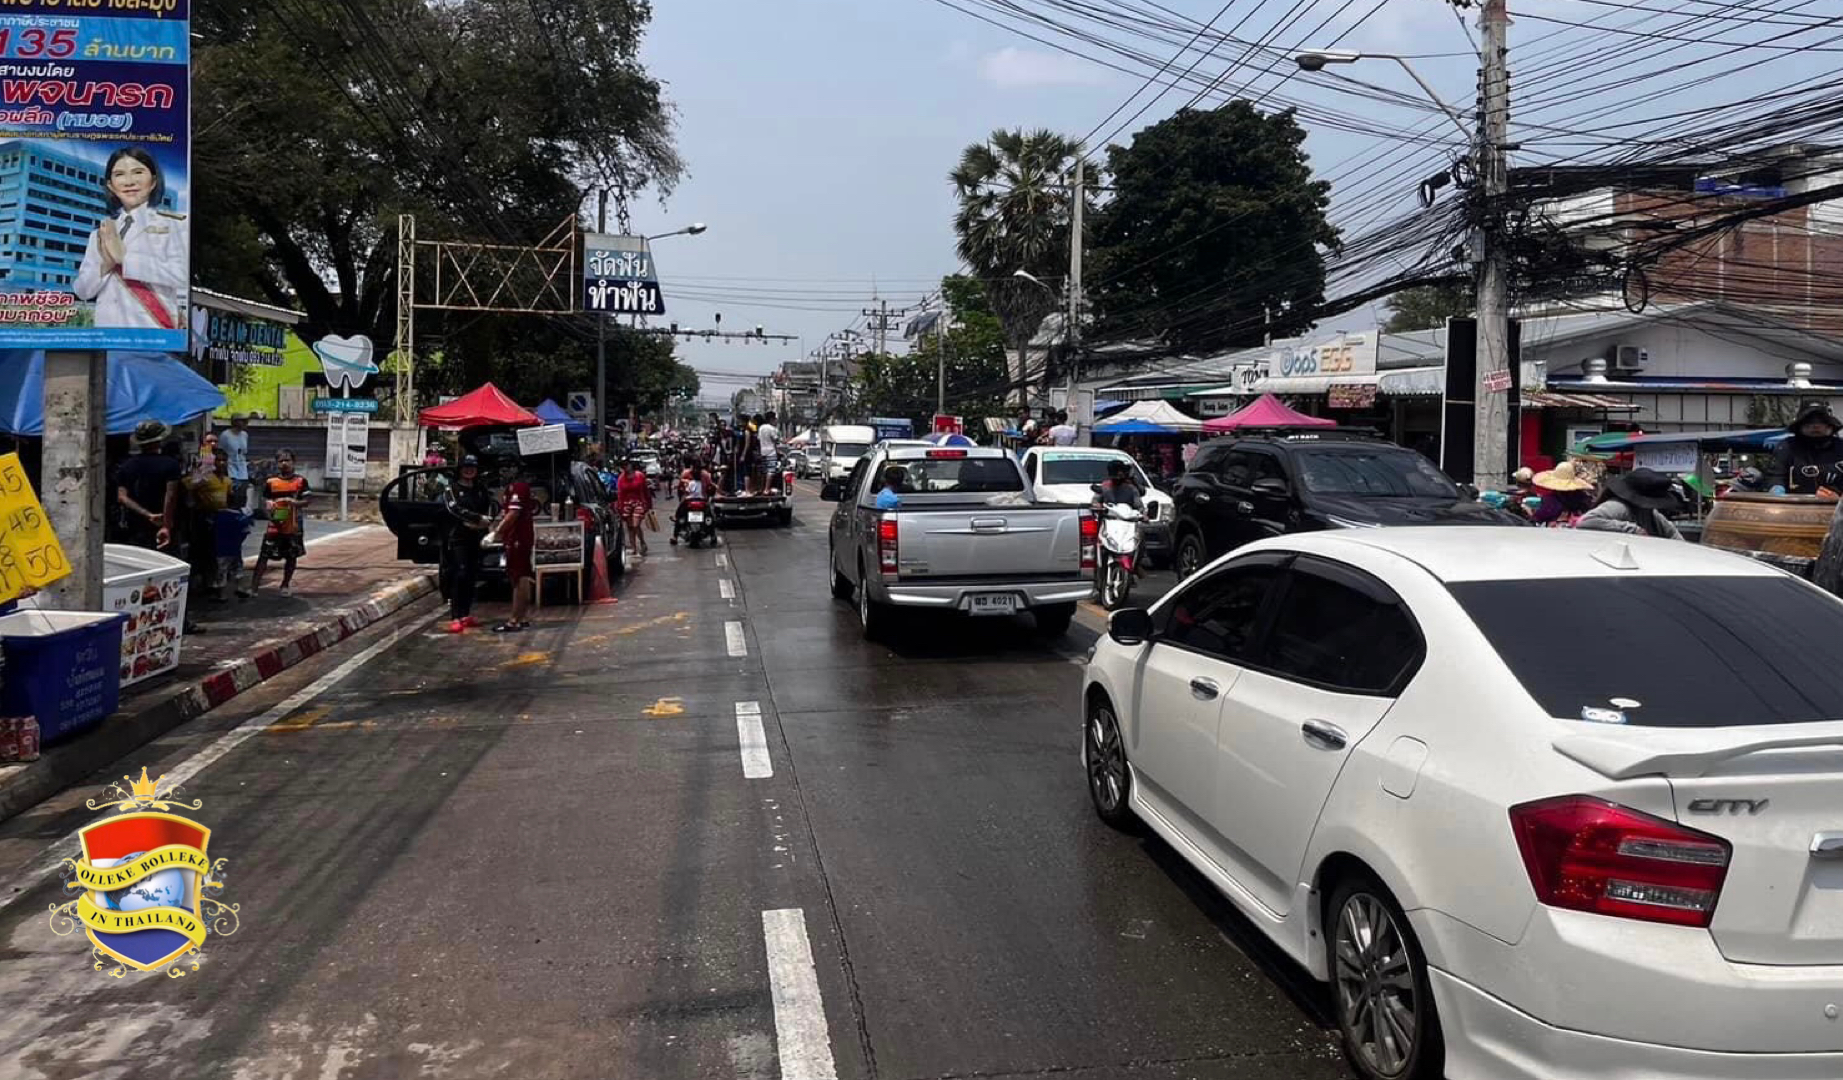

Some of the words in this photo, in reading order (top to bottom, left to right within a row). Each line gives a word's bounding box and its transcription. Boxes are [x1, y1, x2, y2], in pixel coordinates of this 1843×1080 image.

[83, 39, 175, 59] ล้านบาท
[3, 79, 174, 108] พจนารถ
[589, 250, 648, 277] จัดฟัน
[588, 279, 656, 311] ทำฟัน
[9, 506, 41, 532] 45
[25, 544, 62, 579] 50
[1687, 799, 1770, 816] CITY
